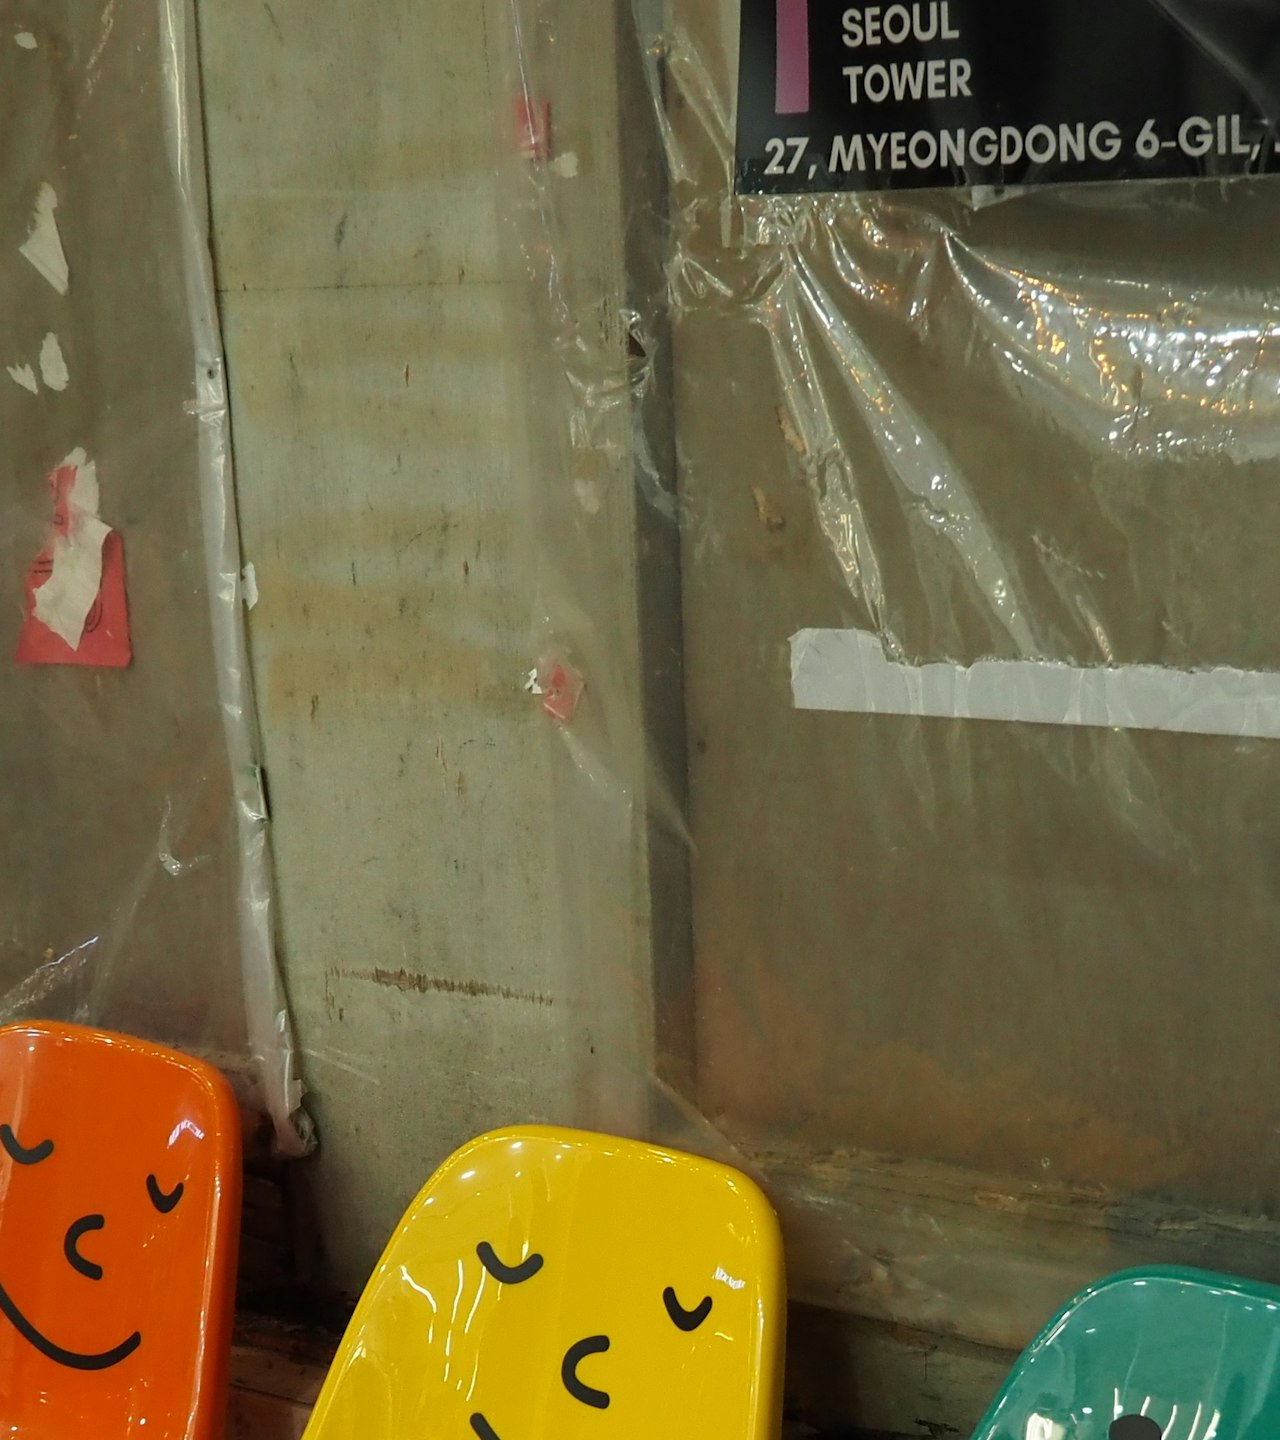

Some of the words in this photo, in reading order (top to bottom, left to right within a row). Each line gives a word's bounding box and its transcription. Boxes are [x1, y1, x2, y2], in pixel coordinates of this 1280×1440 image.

[841, 1, 960, 48] SEOUL
[841, 58, 973, 104] TOWER
[764, 136, 818, 181] 27,
[827, 121, 1122, 173] MYEONGDONG
[1135, 115, 1260, 161] 6-GIL,
